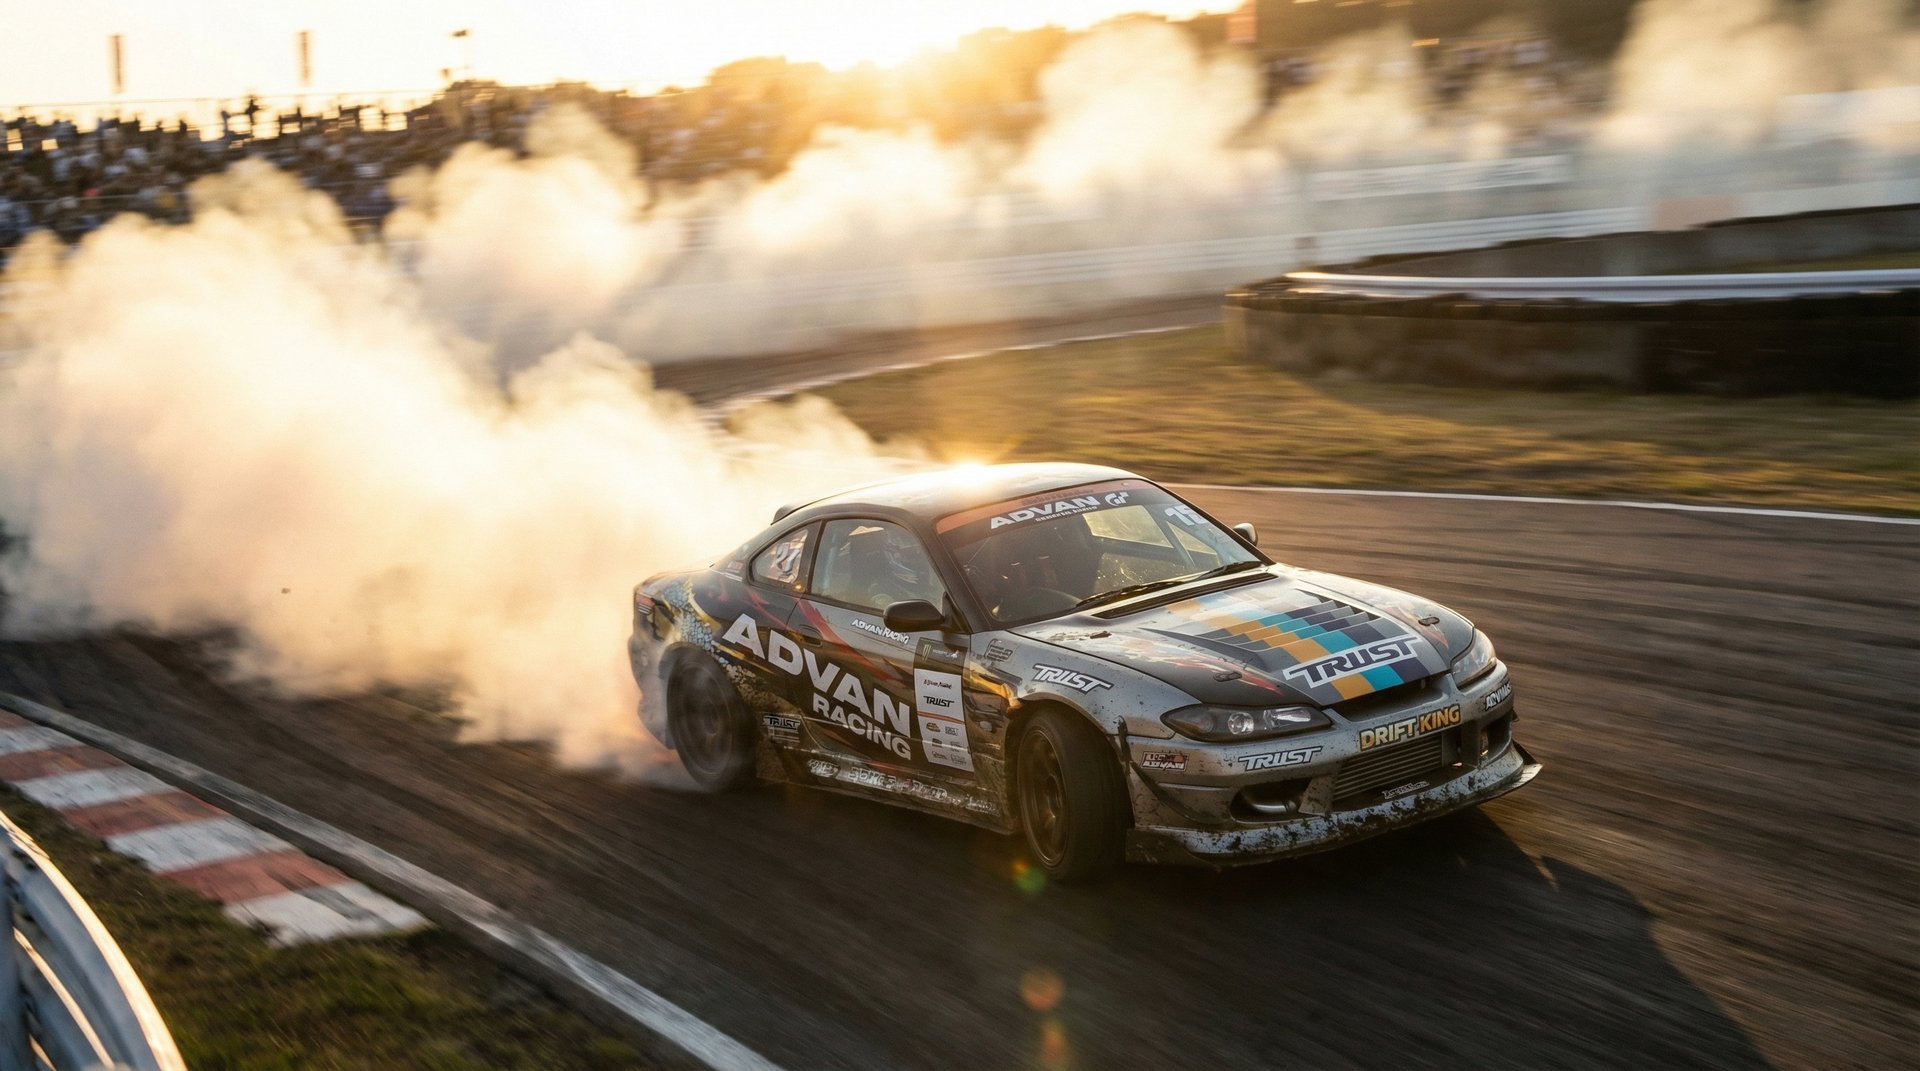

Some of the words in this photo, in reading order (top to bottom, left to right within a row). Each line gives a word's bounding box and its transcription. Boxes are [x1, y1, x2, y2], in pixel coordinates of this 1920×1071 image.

[990, 496, 1100, 529] ADVAN
[851, 619, 883, 636] ADVAN
[882, 627, 910, 645] RACING
[722, 613, 912, 739] ADVAN
[1287, 635, 1420, 685] TRUST
[1034, 664, 1113, 693] TRUST
[923, 695, 955, 708] TRUST
[813, 693, 912, 760] RACING
[1360, 718, 1418, 750] DRIFT
[1419, 704, 1461, 735] KING
[1239, 748, 1321, 771] TRUST
